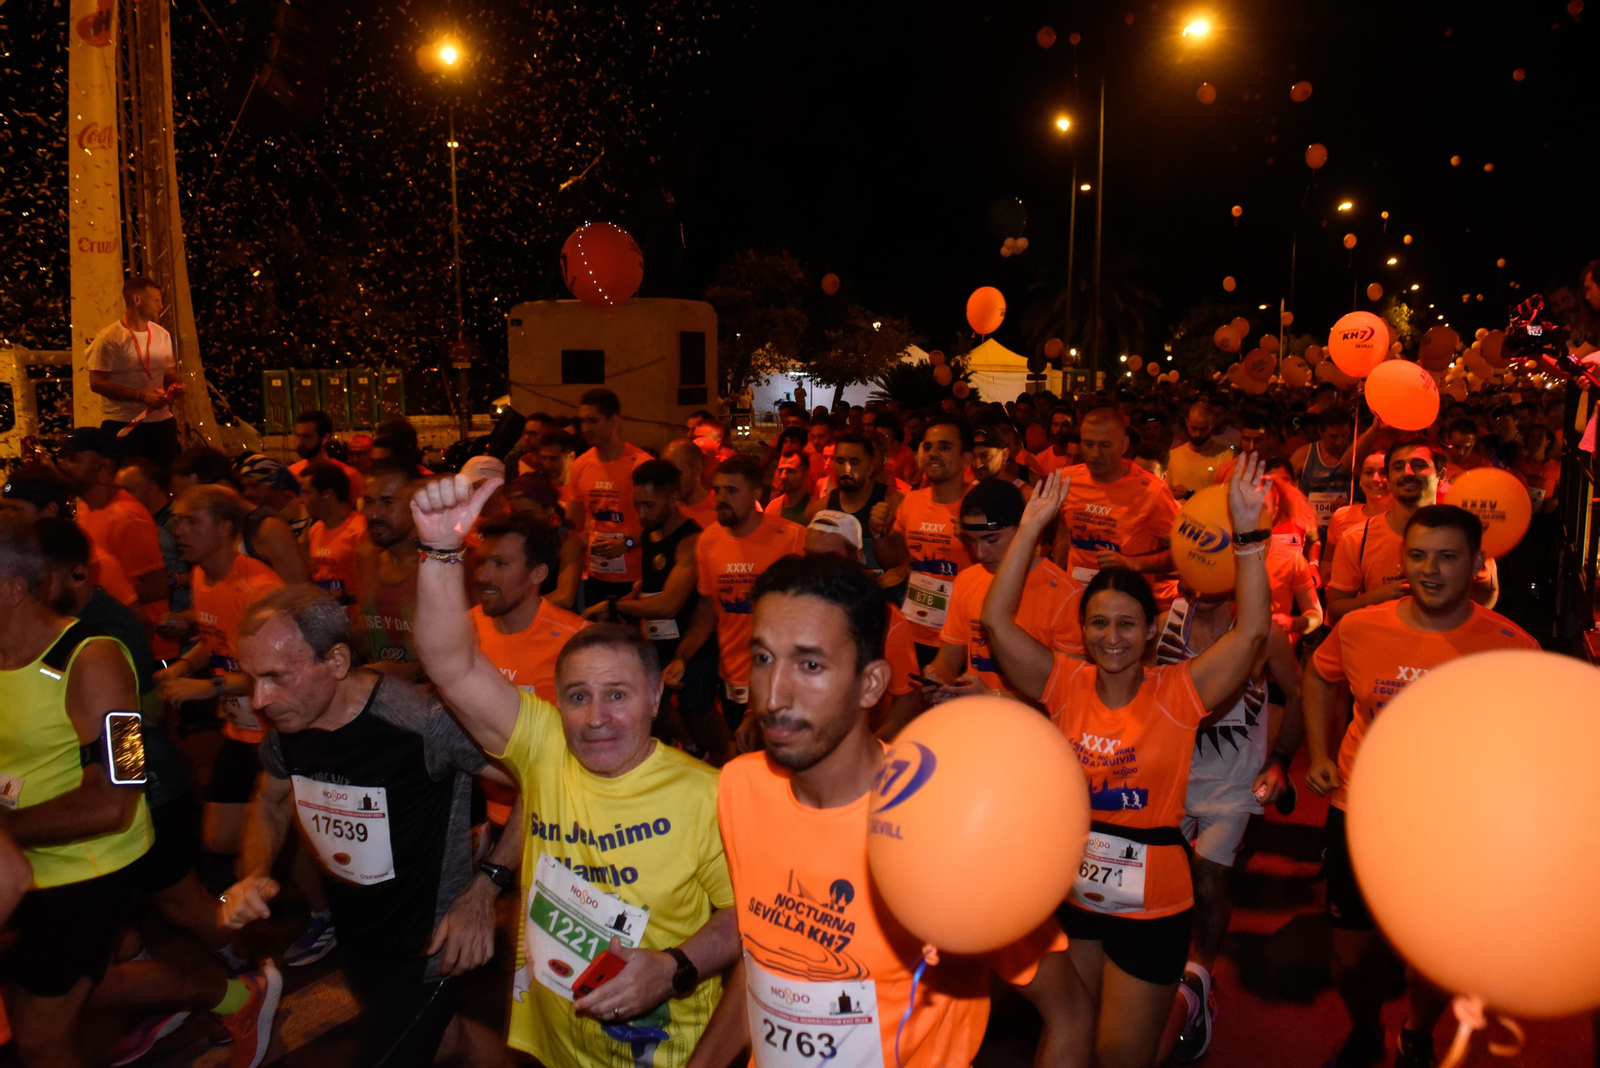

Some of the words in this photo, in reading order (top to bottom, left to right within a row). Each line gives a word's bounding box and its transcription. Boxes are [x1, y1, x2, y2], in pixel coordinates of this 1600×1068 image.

[1085, 503, 1112, 516] XXXV
[920, 521, 946, 533] XXXV
[726, 563, 754, 573] XXXV
[312, 813, 369, 843] 17539
[531, 811, 561, 842] San
[748, 897, 806, 936] SEVILLA
[774, 892, 857, 936] NOCTURNA
[549, 909, 600, 962] 1221
[762, 1017, 838, 1060] 2763
